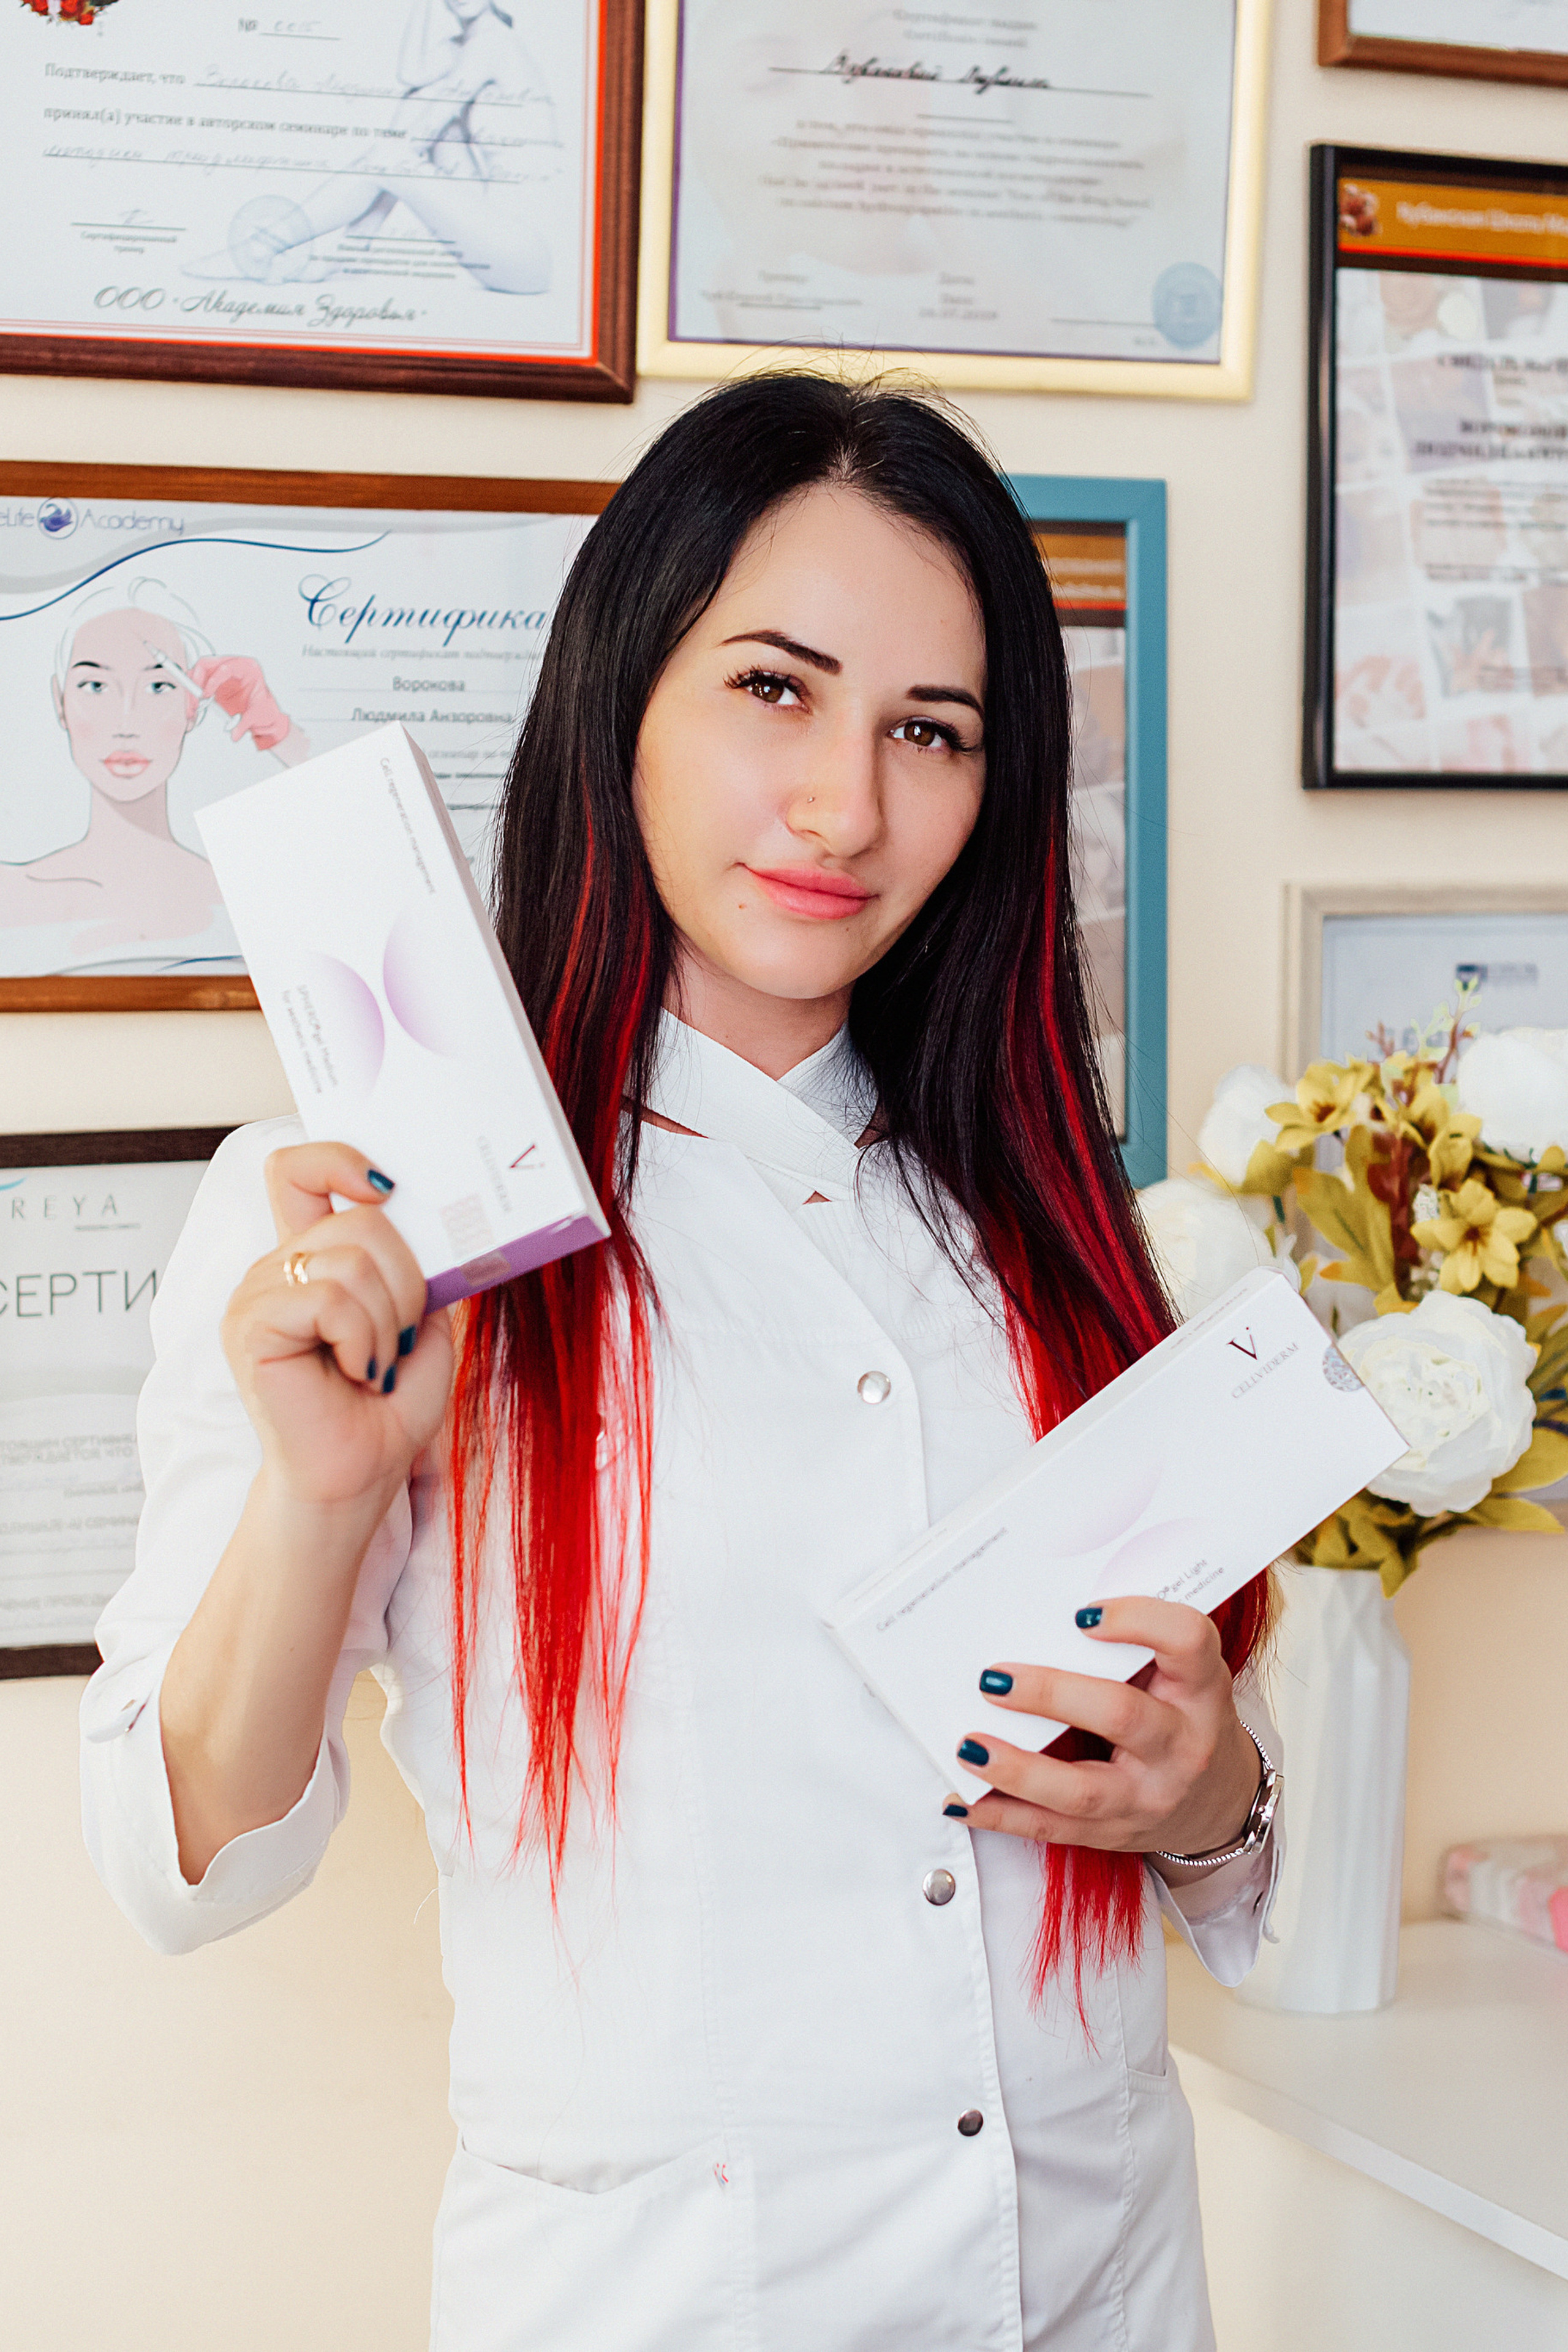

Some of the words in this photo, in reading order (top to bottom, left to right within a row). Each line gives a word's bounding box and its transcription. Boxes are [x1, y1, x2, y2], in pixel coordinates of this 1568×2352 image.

[45, 62, 156, 85] Подтверждает,
[159, 74, 186, 85] что
[44, 108, 121, 125] принял(а)
[124, 113, 183, 126] участие
[186, 116, 195, 126] в
[199, 117, 274, 132] авторском
[279, 122, 348, 138] семинаре
[352, 126, 370, 137] по
[374, 129, 407, 138] теме
[94, 285, 166, 311] ООО
[80, 508, 184, 535] Academy
[298, 574, 547, 647] Сертифика
[351, 707, 426, 723] Людмила
[380, 757, 393, 778] Cell
[388, 778, 413, 835] regeneration
[410, 835, 436, 894] management
[1231, 1342, 1300, 1400] CELLVIDERM
[876, 1615, 897, 1632] Cell
[895, 1570, 953, 1619] regeneration
[952, 1526, 1008, 1574] management
[1183, 1559, 1208, 1579] Light
[1185, 1567, 1224, 1600] medicine
